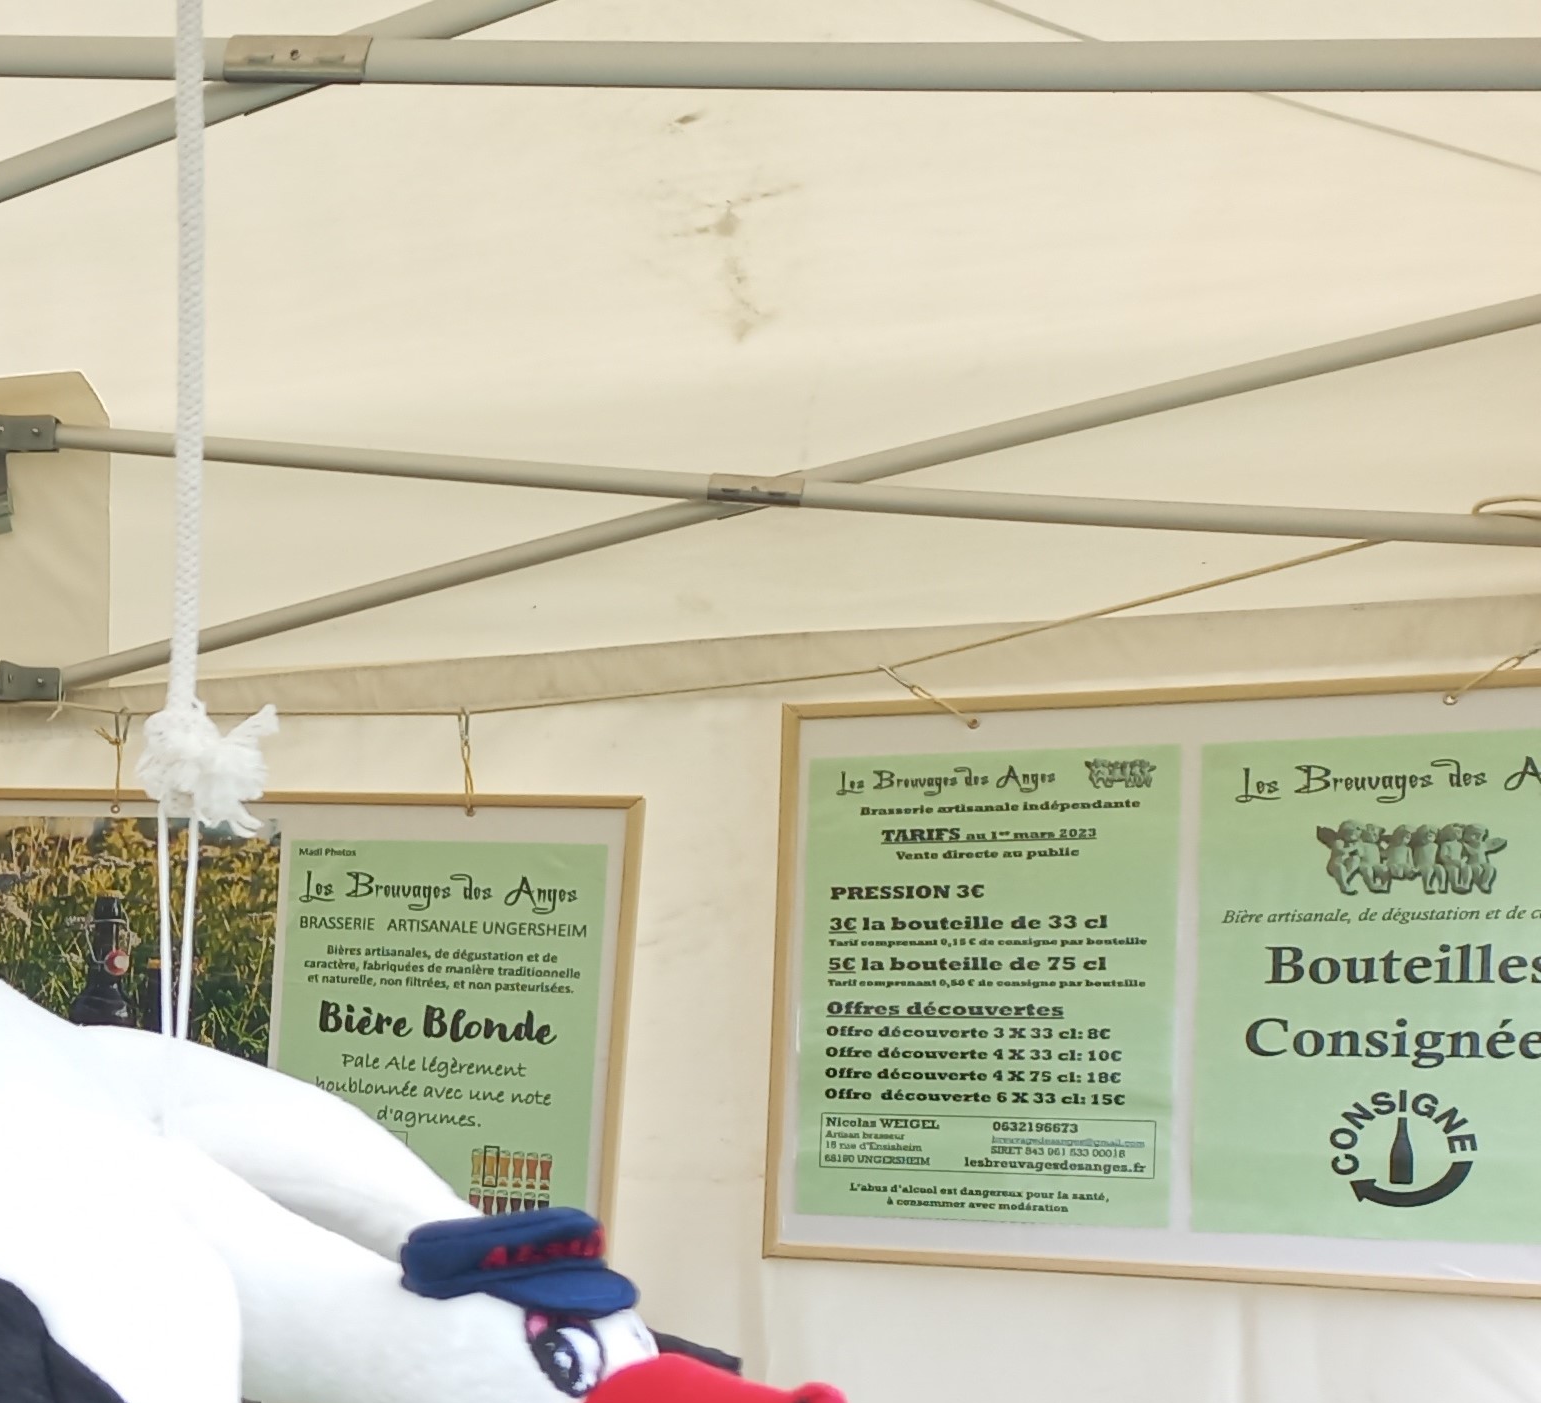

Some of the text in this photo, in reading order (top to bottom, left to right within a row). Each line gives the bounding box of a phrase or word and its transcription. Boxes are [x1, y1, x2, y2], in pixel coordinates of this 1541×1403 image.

[836, 765, 1056, 796] Les Breuvages des Anges
[1235, 759, 1487, 803] Les Breuvages des
[859, 798, 1141, 816] Brasserie artisanale indépendante
[880, 826, 1097, 841] TARIFS au 1er mars 2023
[895, 846, 1080, 860] Vente directe au public
[299, 871, 578, 914] Les Breuvages des Anges
[829, 883, 985, 901] PRESSION 3€
[829, 914, 1108, 933] 3€ la bouteille de 33 cl
[1220, 904, 1527, 925] Bière artisanale, de dégustation et de
[299, 915, 587, 938] BRASSERIE ARTISANALE UNGERSHEIM
[326, 943, 558, 964] Bières artisanales, de dégustation et de
[828, 955, 1107, 973] 5€ la bouteille de 75 cl
[826, 1000, 1064, 1016] Offres découvertes
[318, 999, 557, 1046] Bière Blonde
[825, 1024, 1111, 1040] Offre découverte 3 X 33 cl: 8€
[340, 1052, 527, 1078] Pale Ale légèrement
[316, 1076, 552, 1106] houblonnée avec une note
[824, 1087, 1125, 1106] Offre découverte 6 X 33 cl: 15€
[377, 1105, 482, 1127] d'agrumes.
[825, 1116, 940, 1130] Nicolas WEIGEL
[1329, 1089, 1478, 1176] CONSIGNE
[963, 1155, 1147, 1175] lesbreuvagesdesanges.fr
